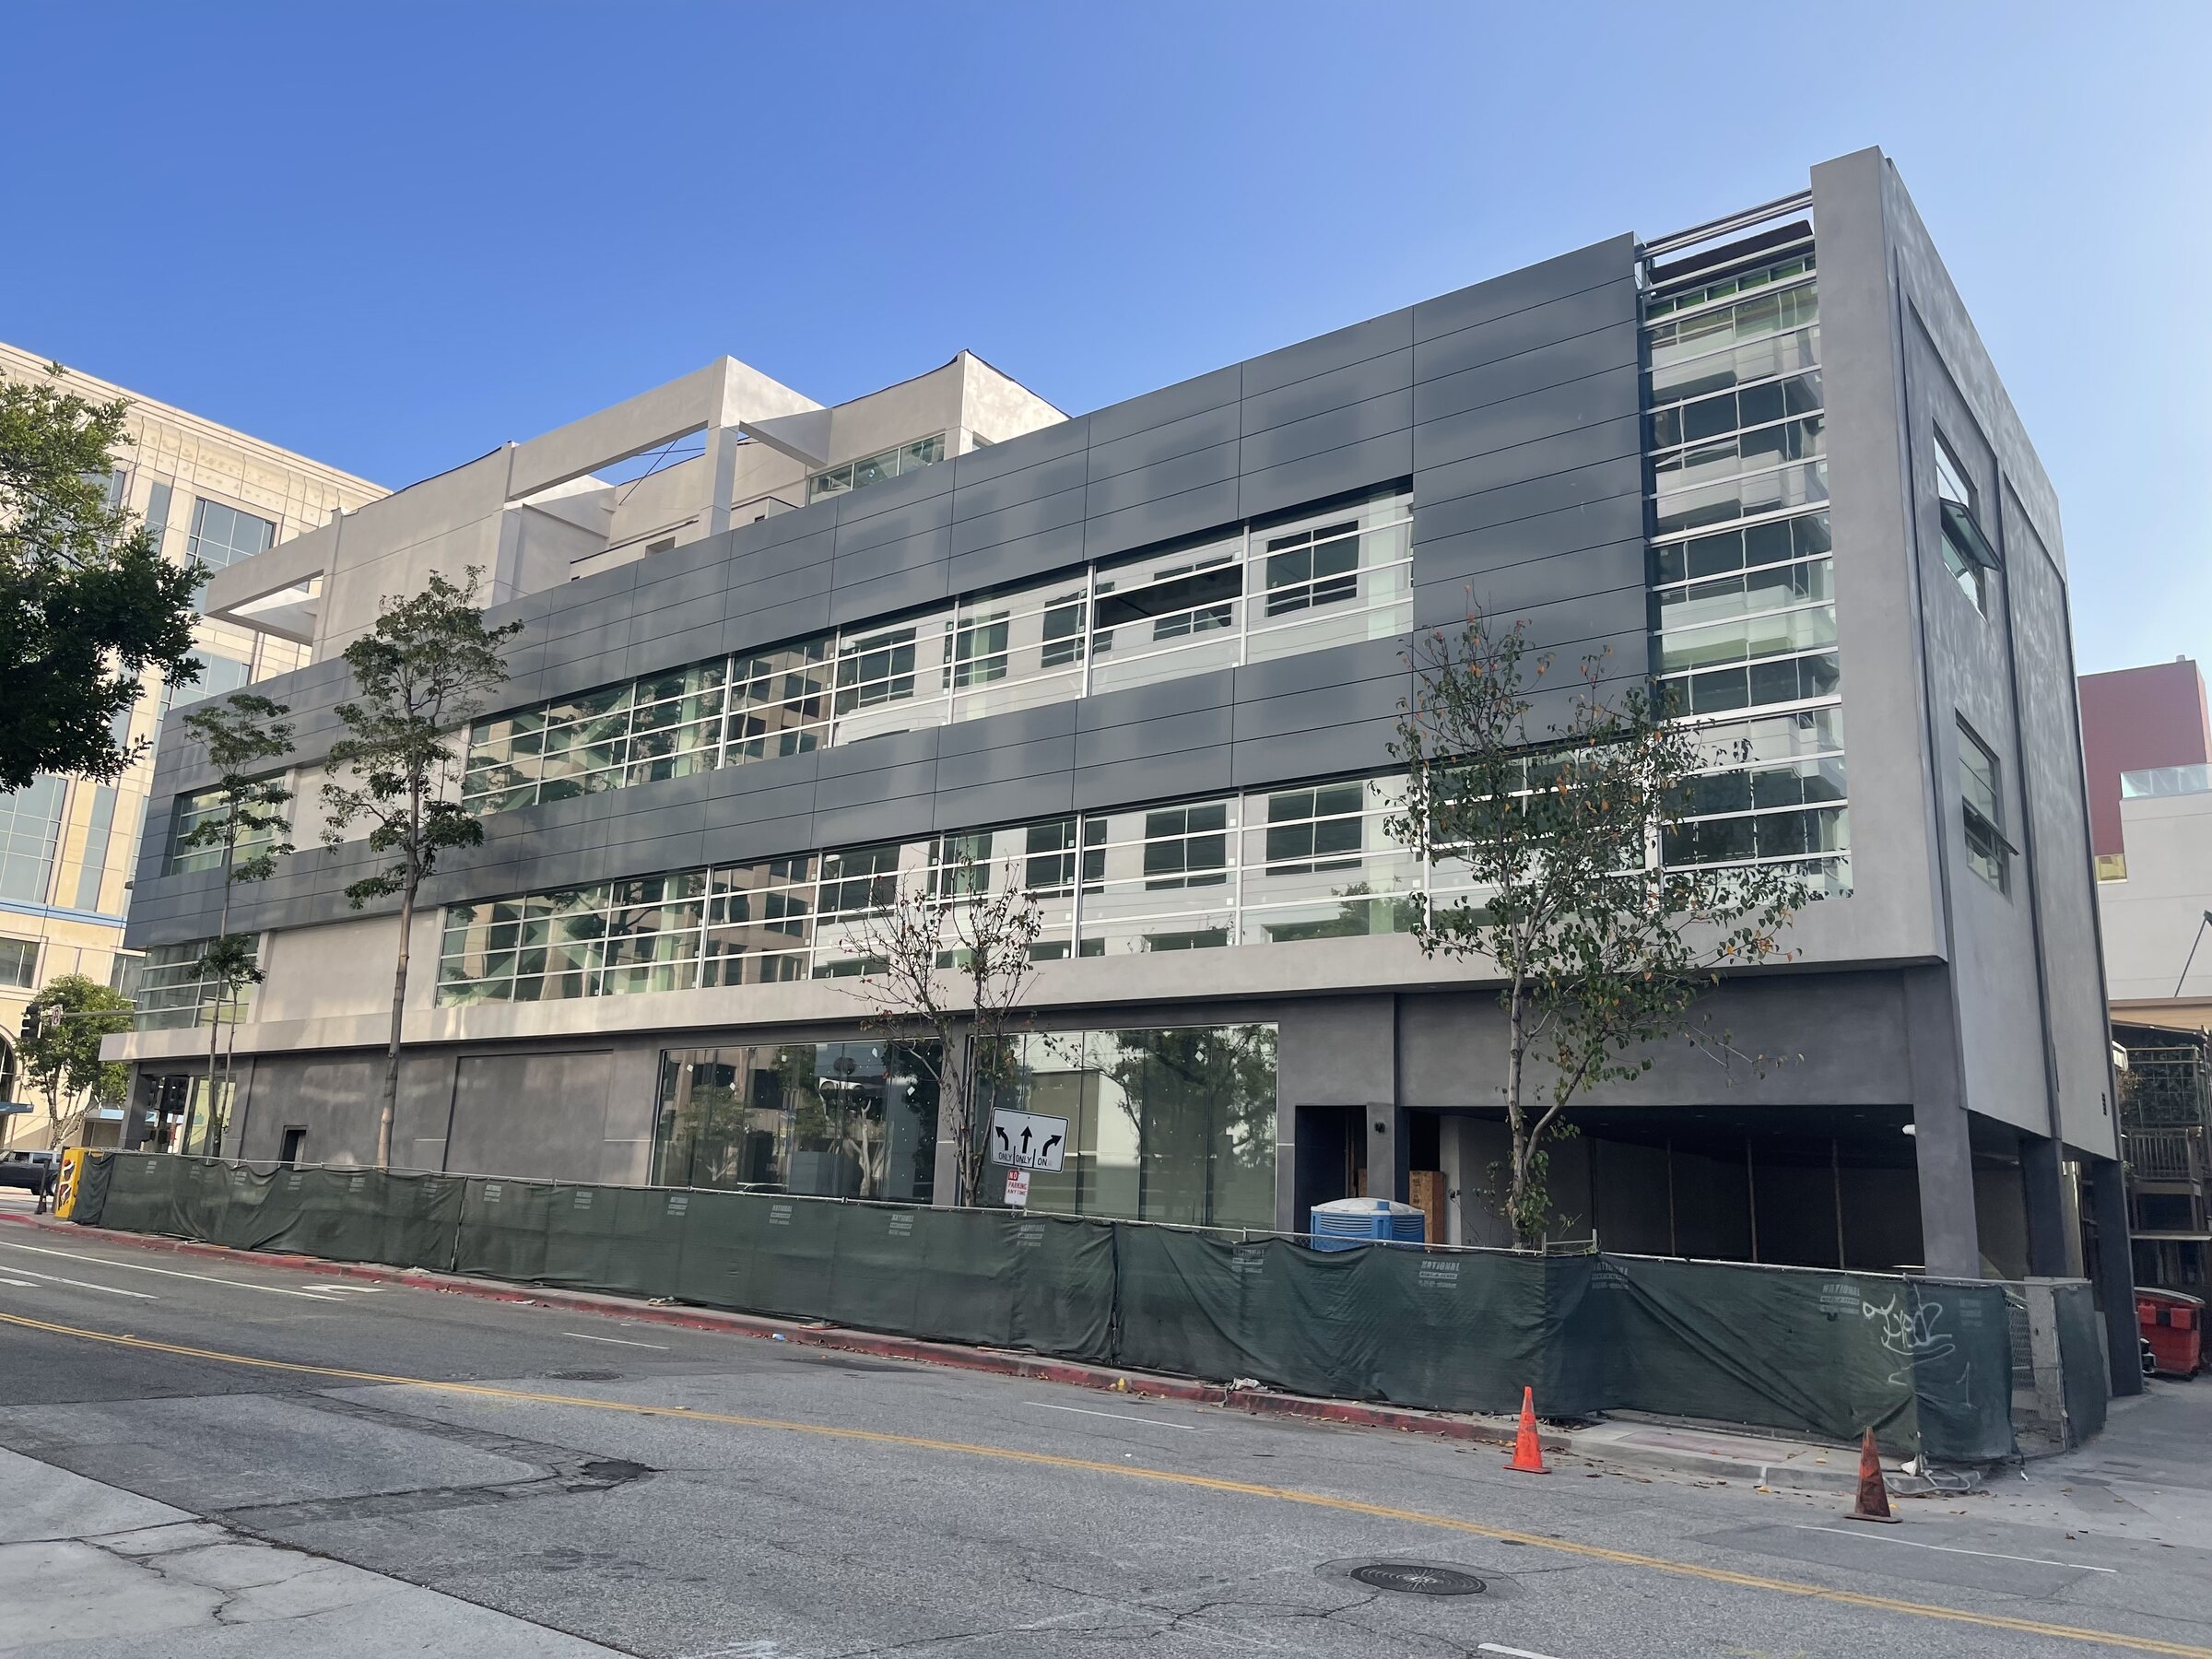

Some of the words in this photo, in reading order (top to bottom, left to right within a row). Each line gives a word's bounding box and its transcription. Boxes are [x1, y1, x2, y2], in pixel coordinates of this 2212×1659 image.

[998, 1152, 1013, 1161] ONLY
[1015, 1154, 1032, 1164] ONLY
[1008, 1171, 1018, 1180] NO
[1008, 1182, 1028, 1190] PARKING
[1420, 1260, 1460, 1272] NATIONAL
